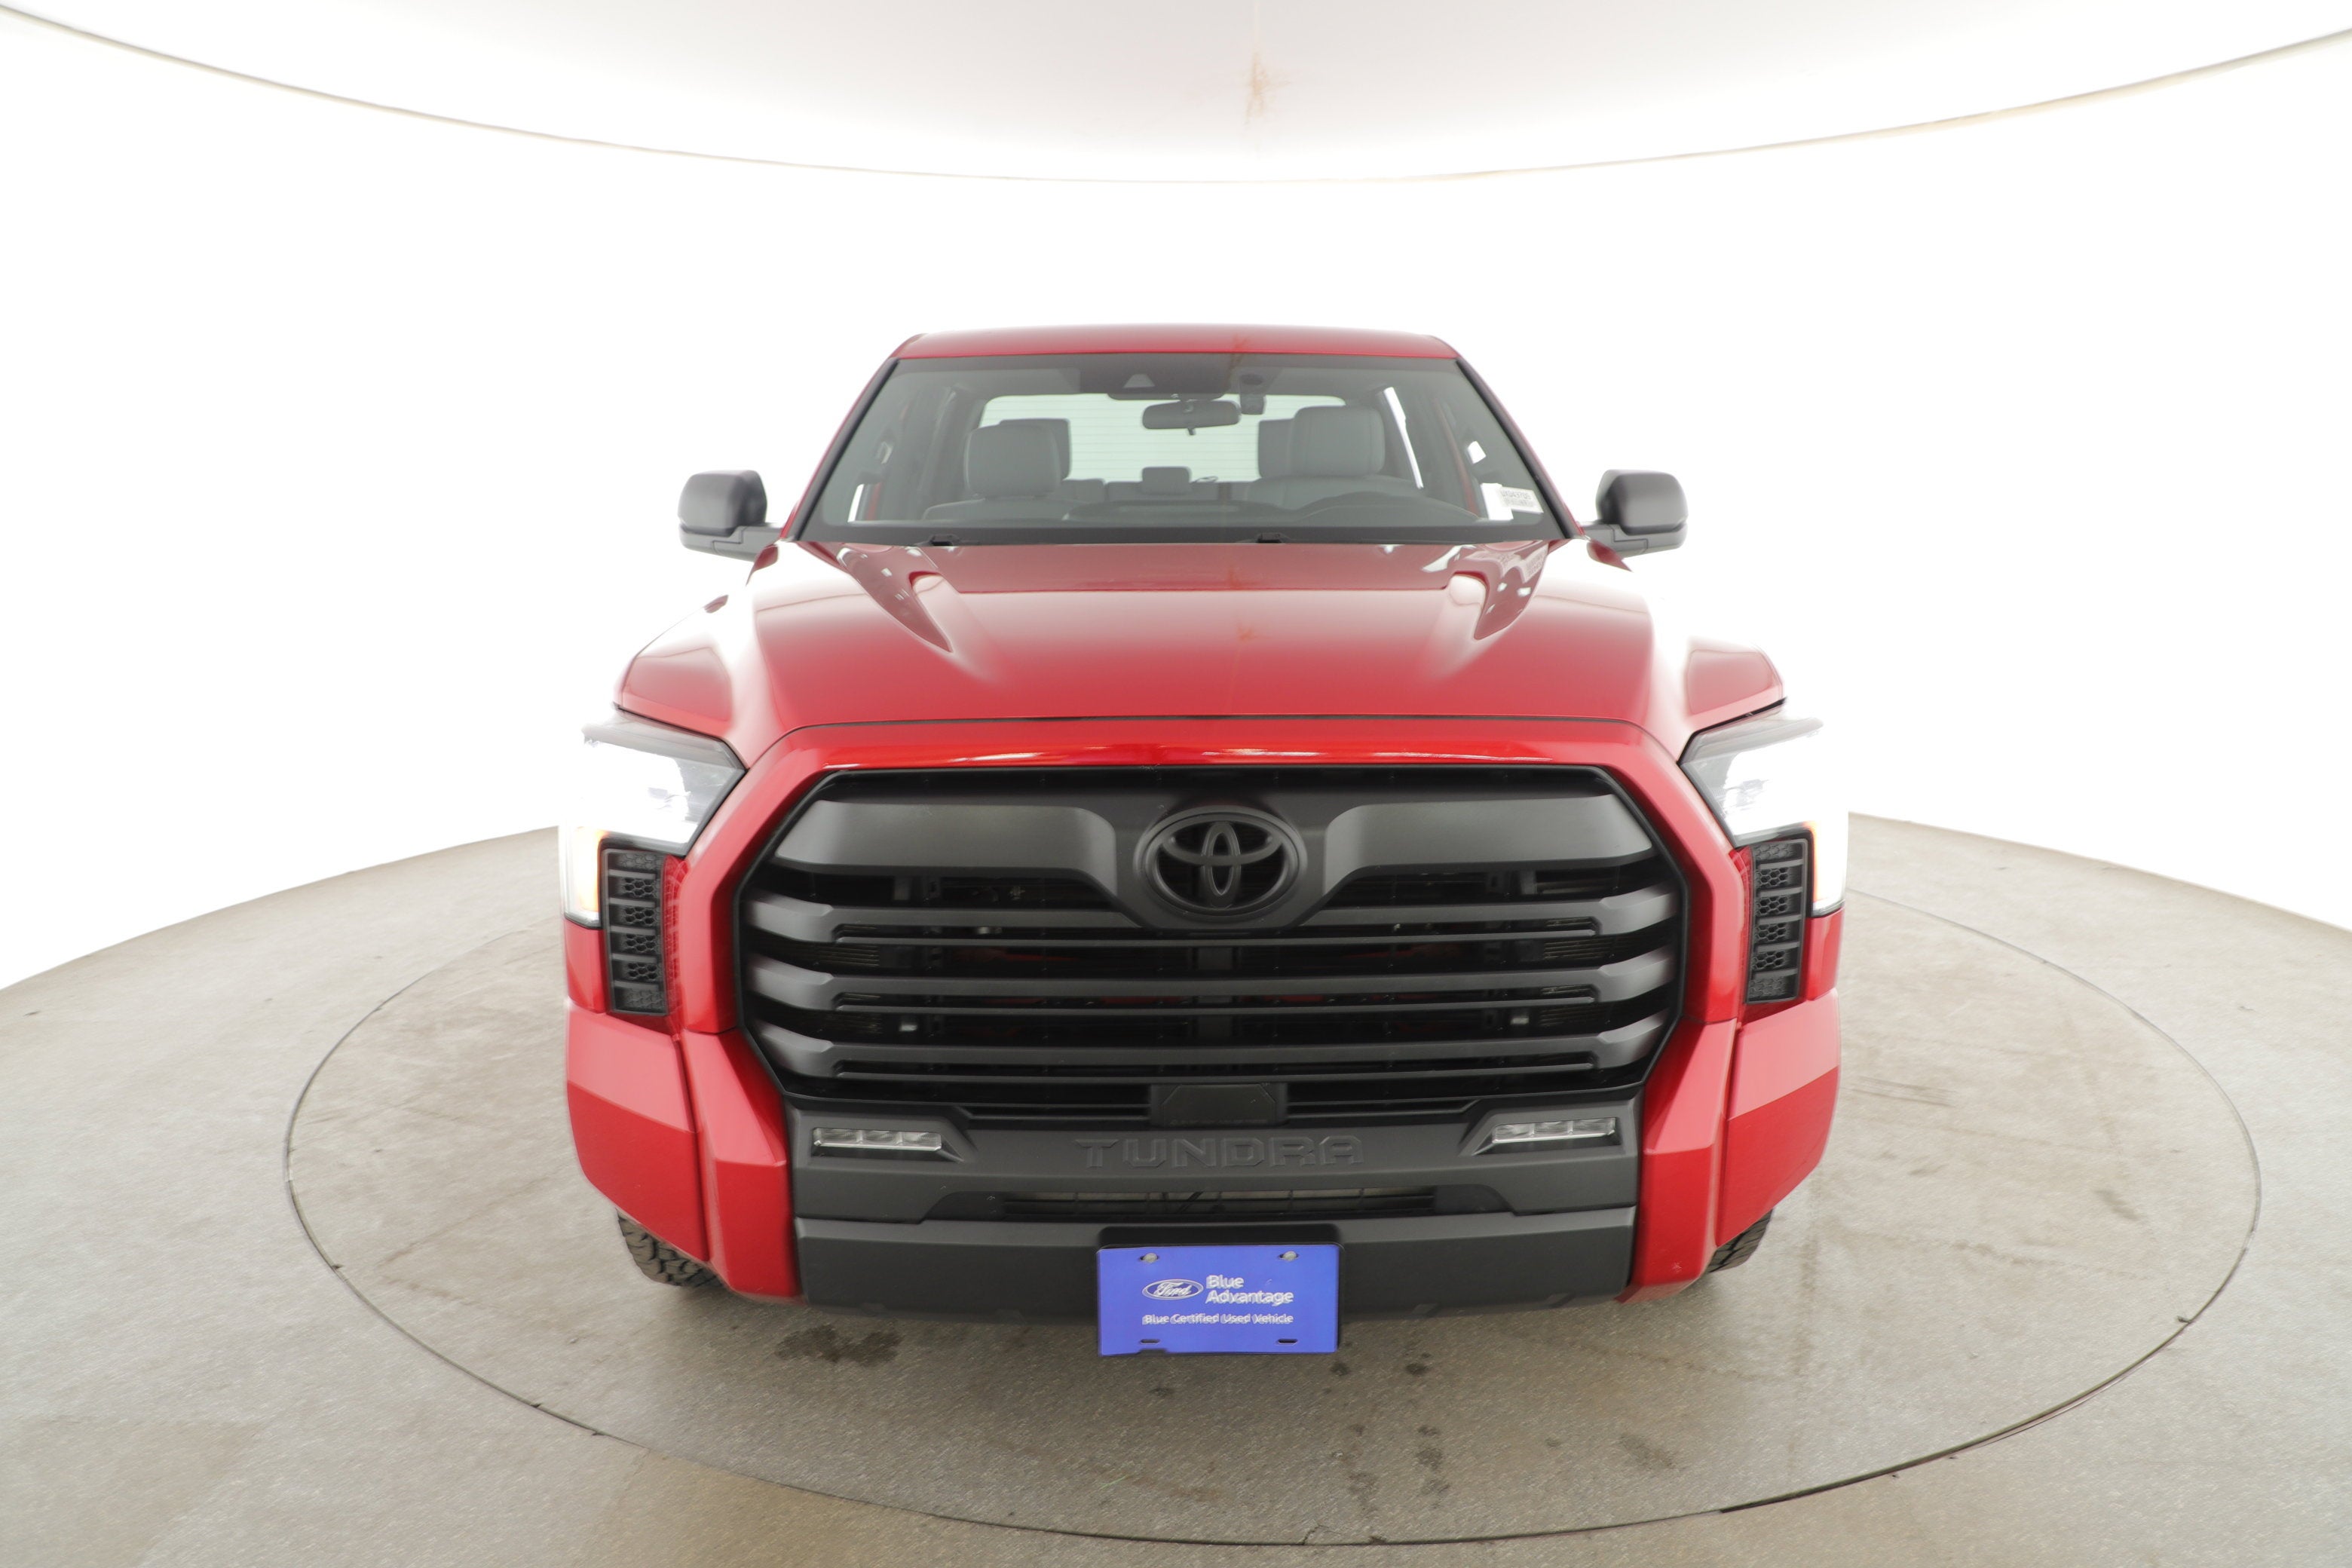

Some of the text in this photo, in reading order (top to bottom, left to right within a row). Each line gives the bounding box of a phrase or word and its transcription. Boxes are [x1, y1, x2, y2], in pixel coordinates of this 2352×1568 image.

[1075, 1135, 1364, 1168] TUNDRA
[1206, 1275, 1244, 1288] Blue
[1153, 1282, 1192, 1297] Ford
[1205, 1290, 1294, 1306] Advantage
[1142, 1313, 1294, 1325] Blue Certified Used Vehicle
